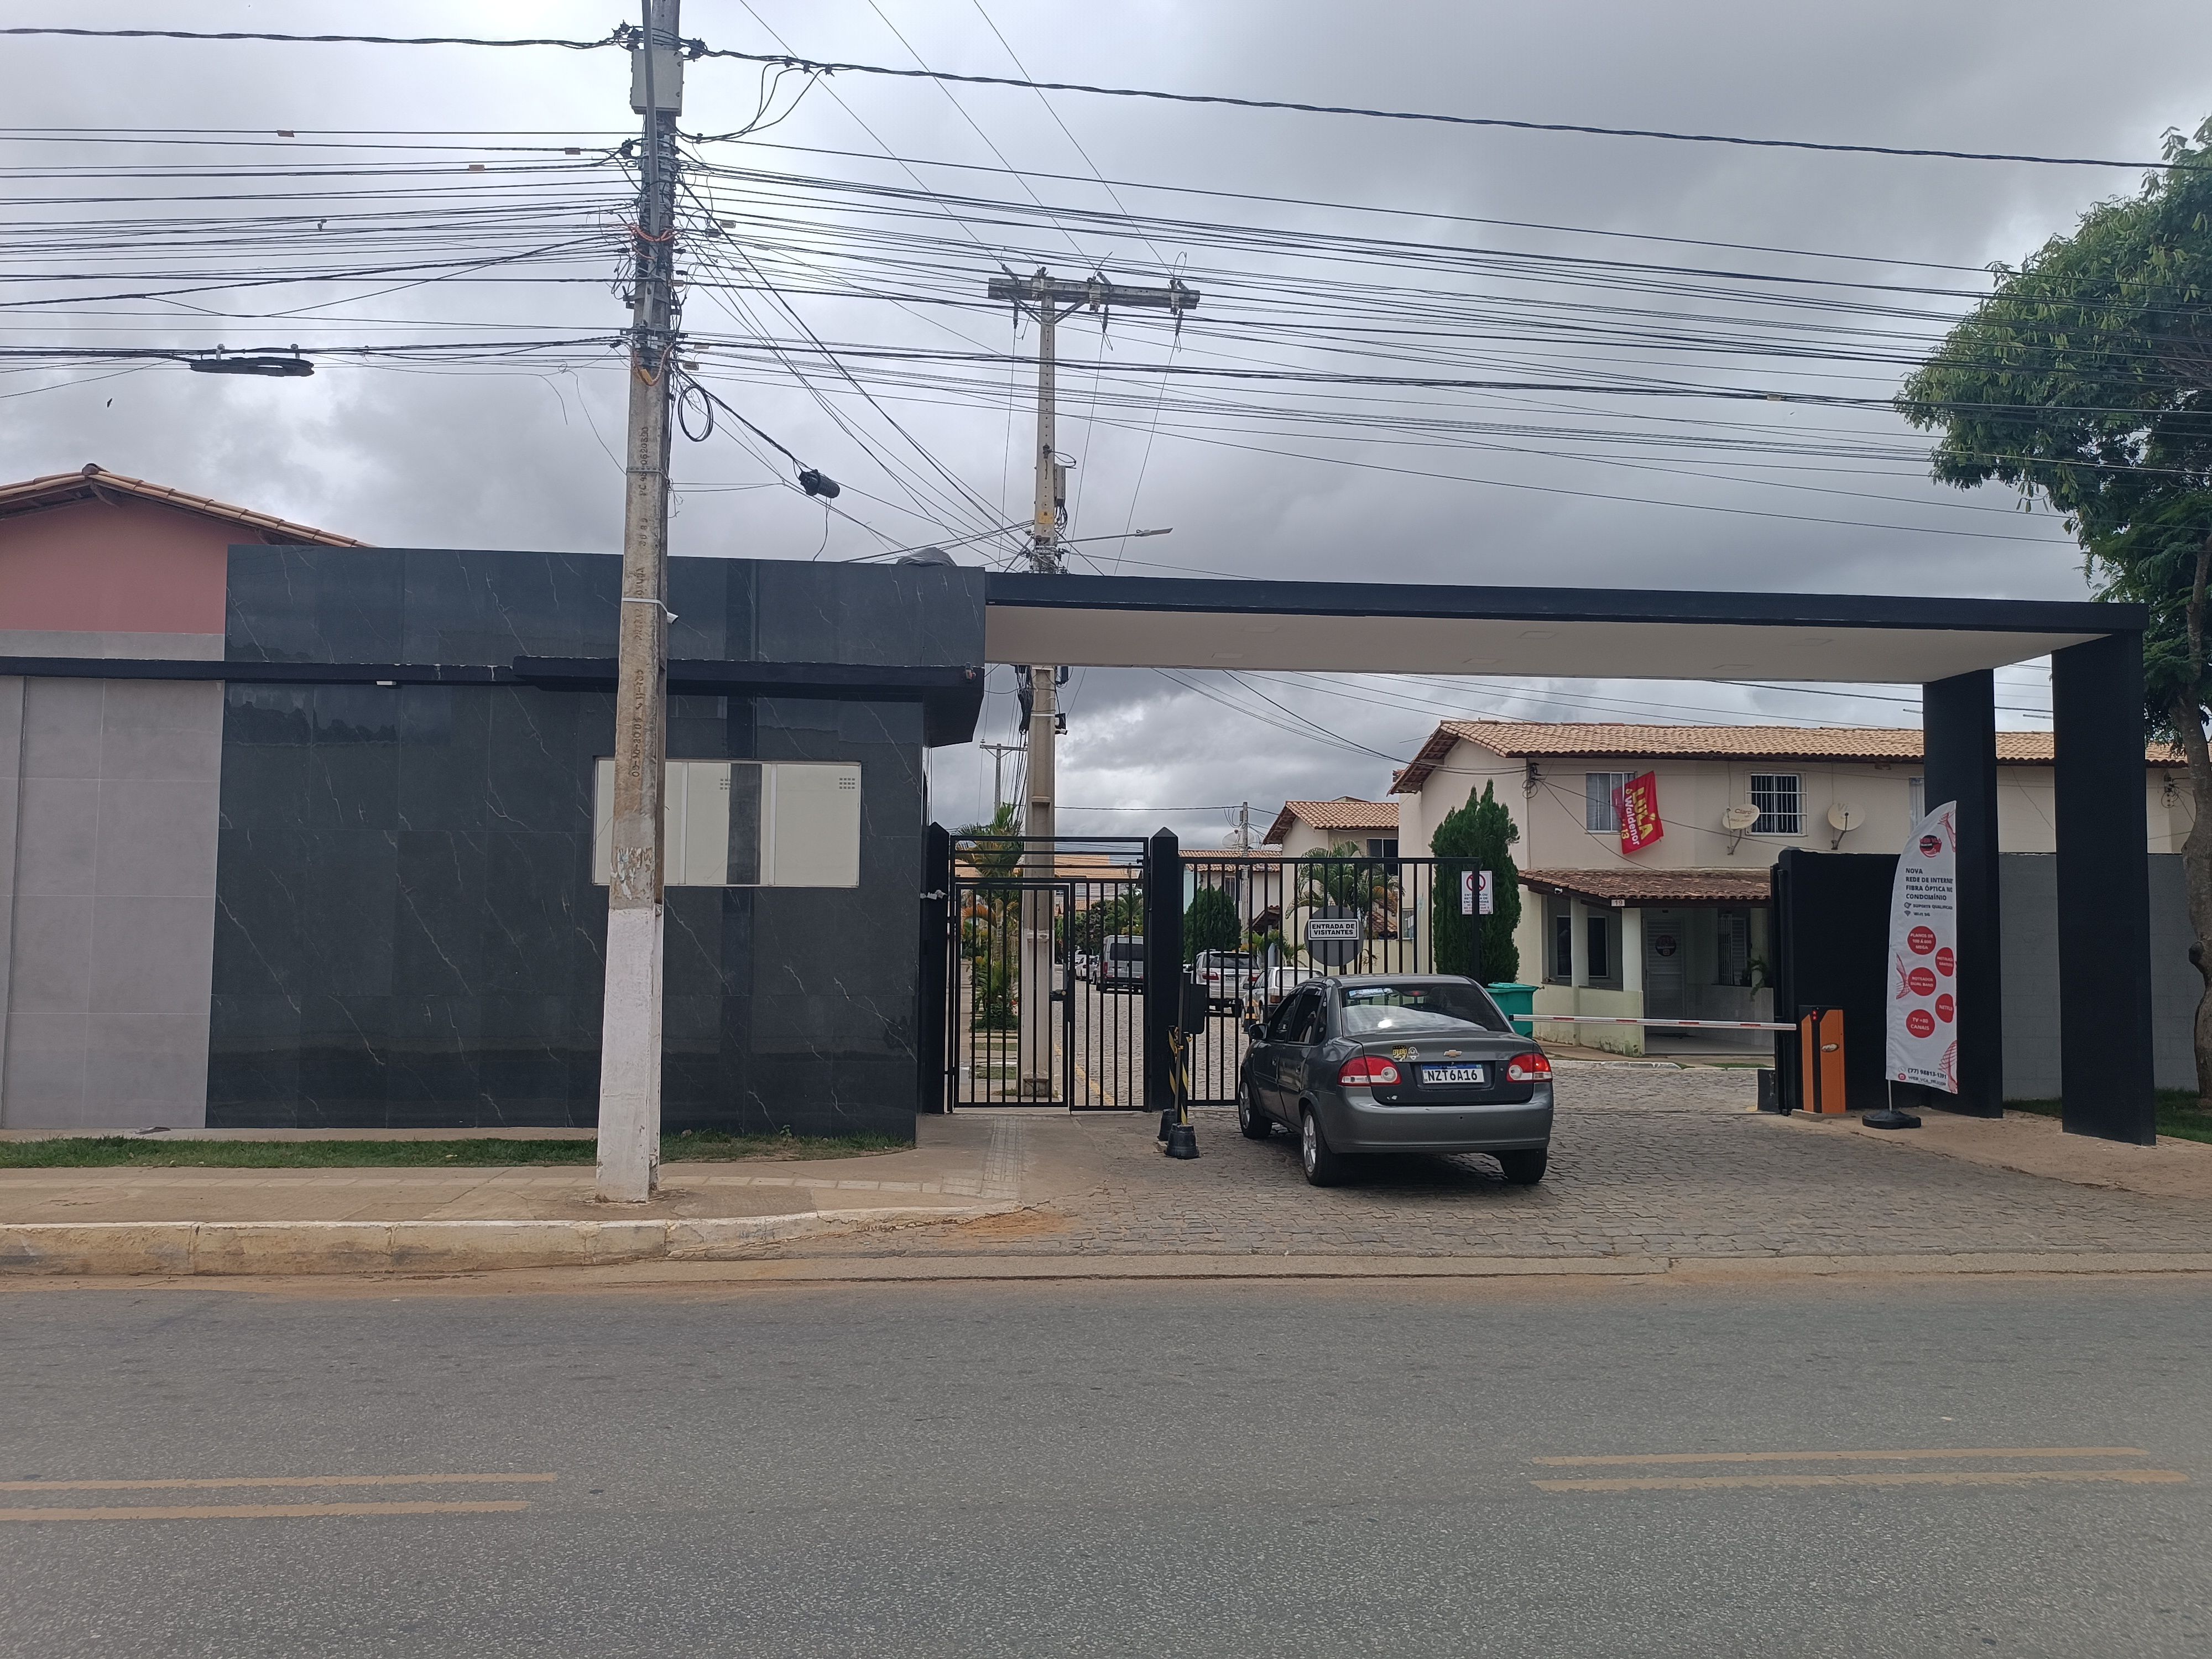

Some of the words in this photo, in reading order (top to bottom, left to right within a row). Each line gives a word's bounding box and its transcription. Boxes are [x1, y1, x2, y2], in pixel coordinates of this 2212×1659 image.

[1625, 795, 1640, 846] Waldenor
[1632, 787, 1653, 840] LULA
[1428, 1070, 1478, 1081] NZT6A16
